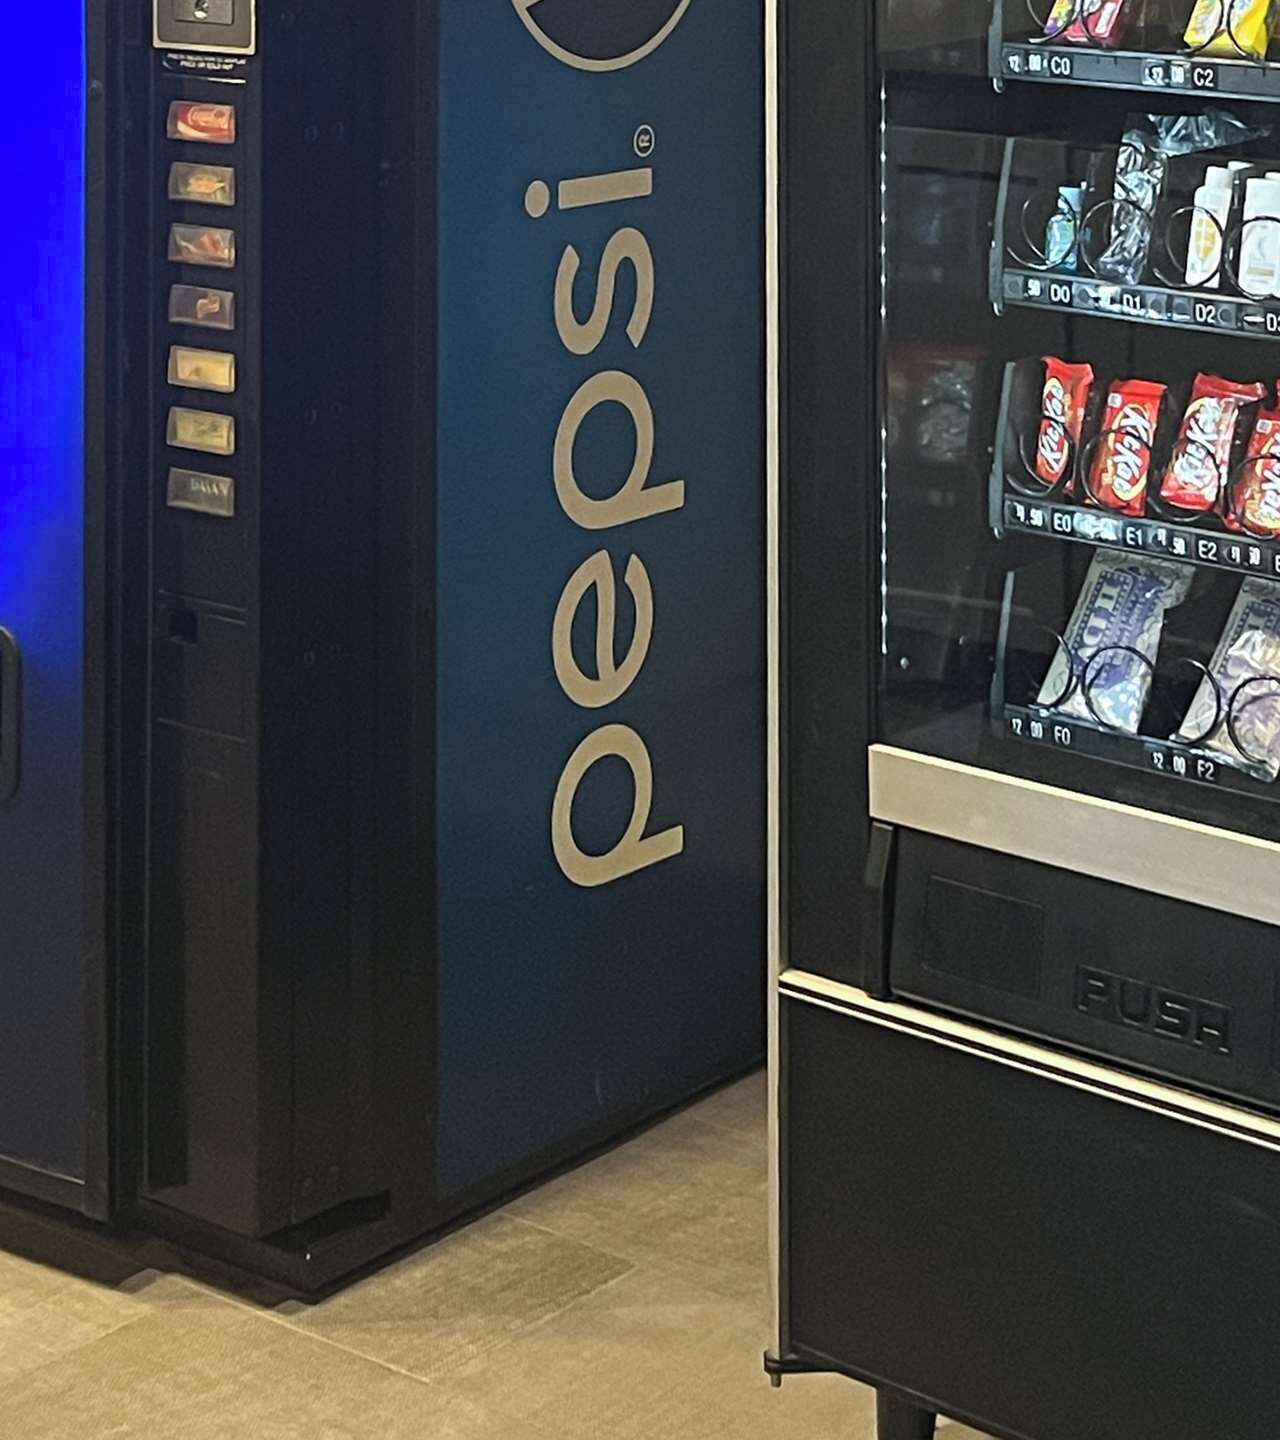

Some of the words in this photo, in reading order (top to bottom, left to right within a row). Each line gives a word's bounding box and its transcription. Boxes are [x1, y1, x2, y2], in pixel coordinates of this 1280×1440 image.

[1051, 56, 1071, 76] C0
[1193, 68, 1214, 87] C2
[1051, 284, 1070, 303] D0
[1195, 303, 1216, 323] D2
[524, 166, 686, 889] pepsi
[1054, 511, 1072, 532] E0
[1126, 526, 1142, 545] E1
[1198, 539, 1217, 559] E2
[1054, 729, 1071, 745] F0
[1197, 757, 1215, 778] F2
[1074, 965, 1232, 1053] PUSH
